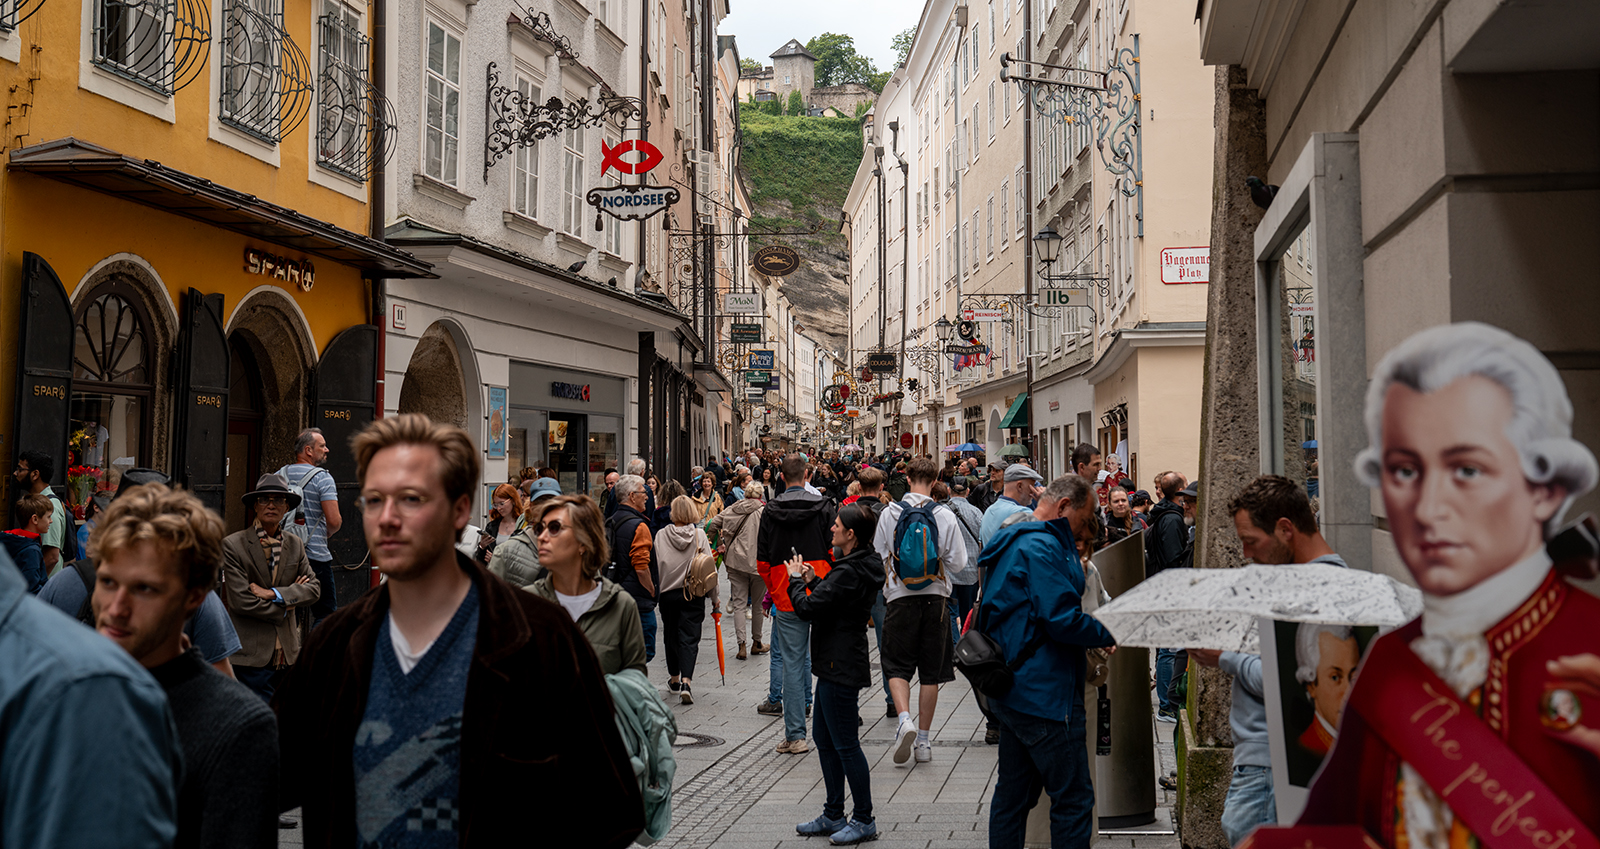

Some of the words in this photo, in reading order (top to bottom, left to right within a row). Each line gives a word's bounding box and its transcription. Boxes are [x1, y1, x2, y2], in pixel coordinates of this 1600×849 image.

[603, 193, 663, 207] NORDSEE
[246, 249, 299, 283] SPAR
[729, 296, 754, 305] Madl
[34, 385, 58, 397] SPAR
[197, 395, 215, 405] SPAR
[325, 410, 345, 418] SPAR
[1410, 682, 1462, 761] The
[1441, 762, 1577, 849] perfect
